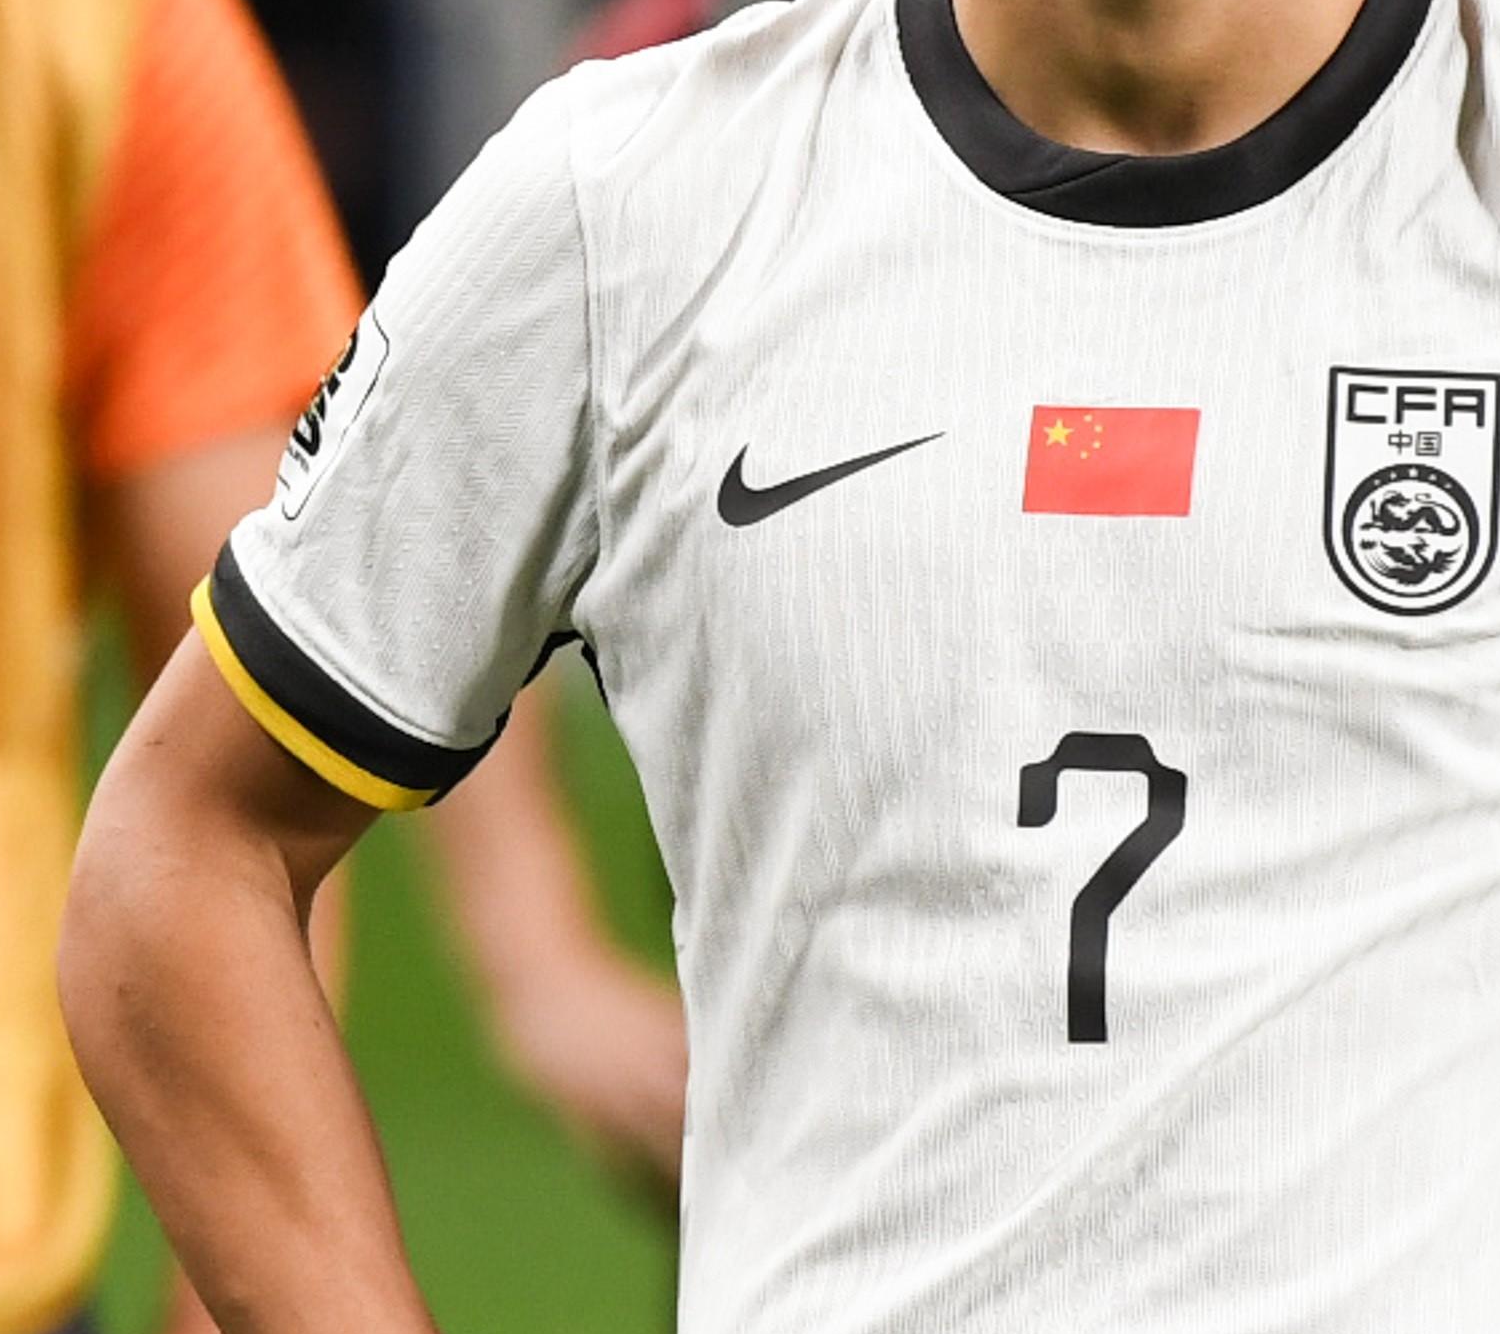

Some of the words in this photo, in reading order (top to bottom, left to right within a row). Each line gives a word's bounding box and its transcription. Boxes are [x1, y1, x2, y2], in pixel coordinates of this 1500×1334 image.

[1346, 383, 1486, 428] CFA
[1387, 429, 1442, 457] 中国
[1017, 731, 1188, 1044] 7
